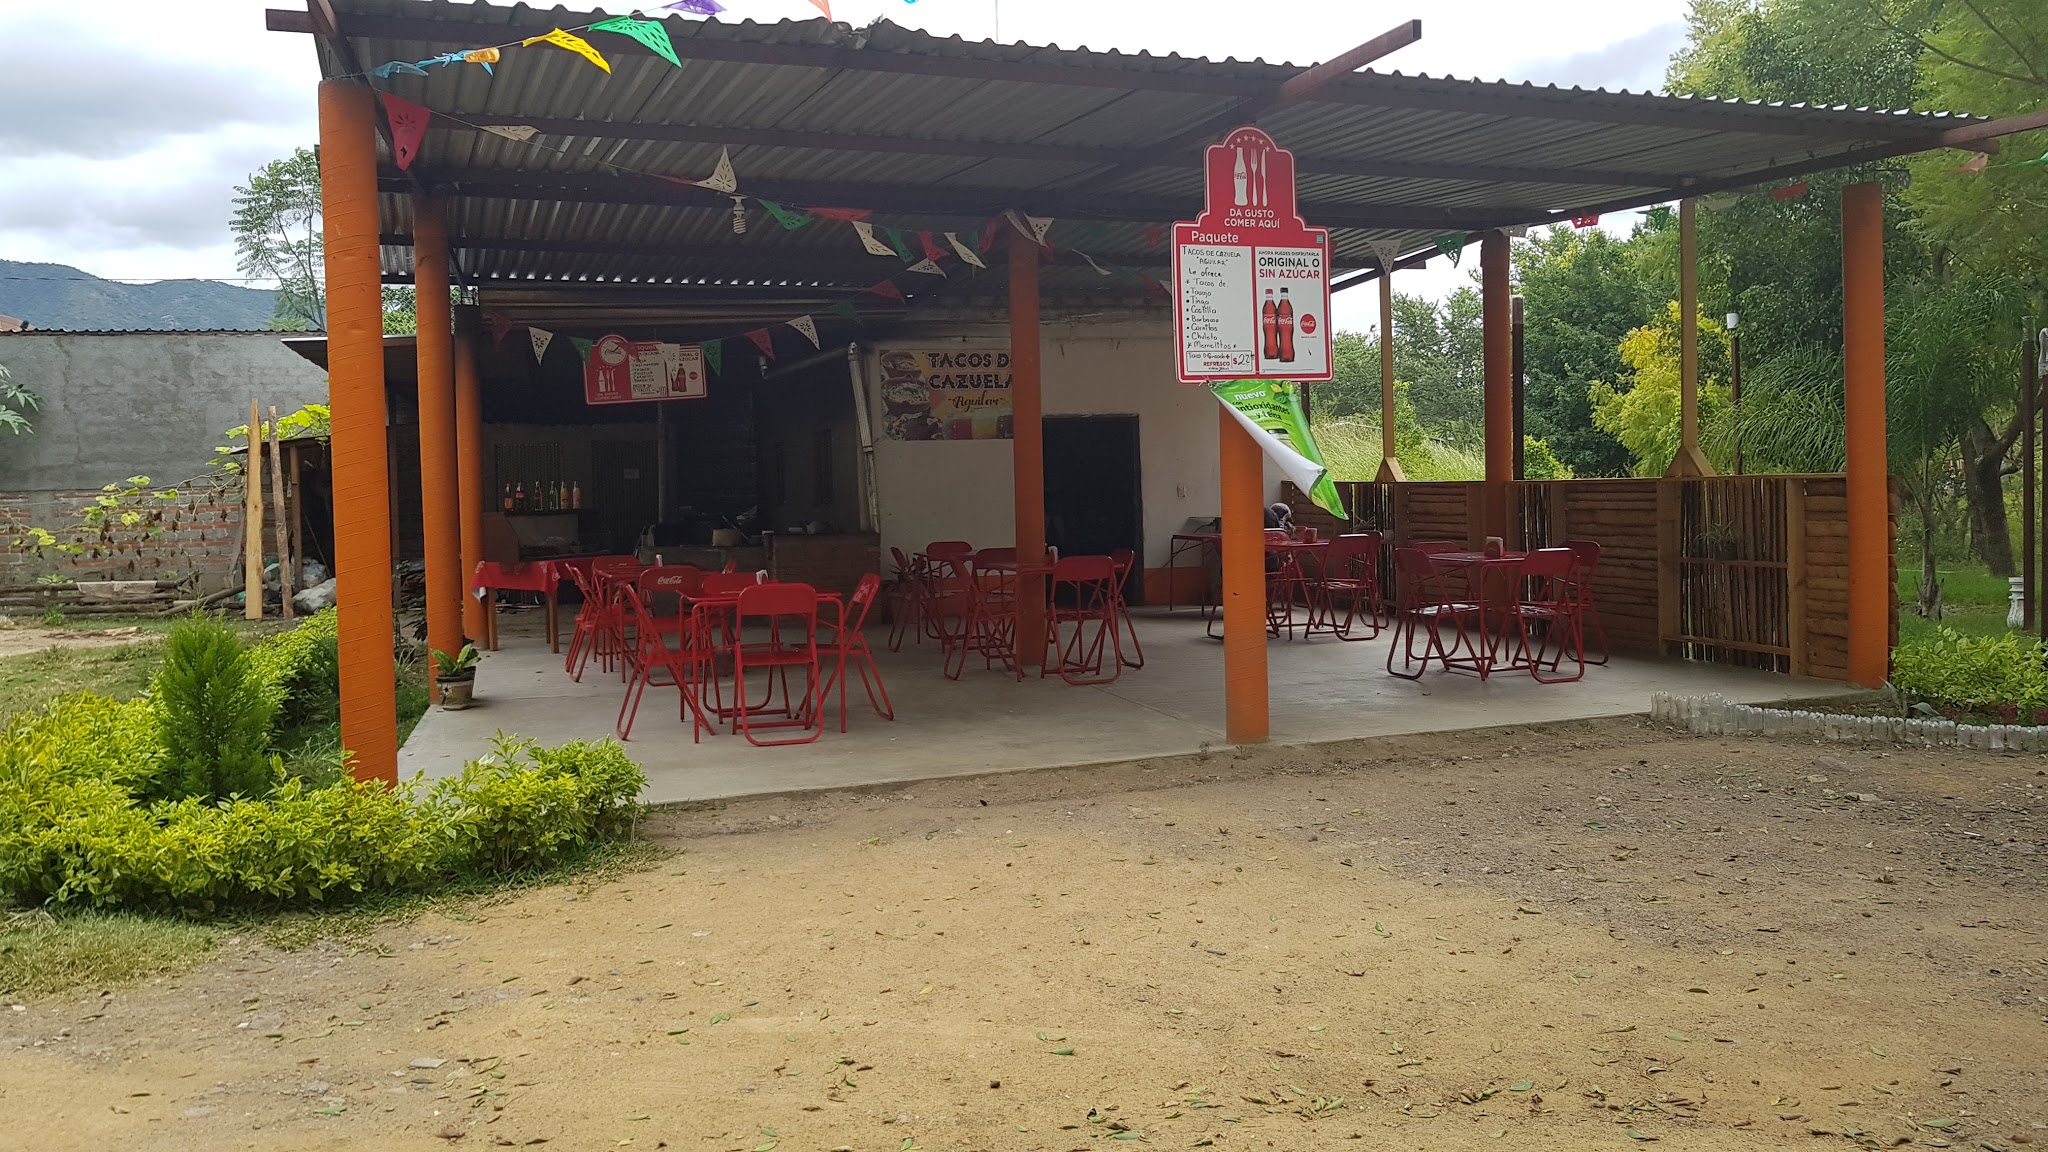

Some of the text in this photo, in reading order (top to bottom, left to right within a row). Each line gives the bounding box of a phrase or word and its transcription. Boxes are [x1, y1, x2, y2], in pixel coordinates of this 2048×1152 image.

[1229, 208, 1274, 218] DA GUSTO
[1224, 218, 1280, 228] COMER AQUÍ
[1191, 230, 1239, 244] Paquete
[1182, 246, 1204, 256] TACOS
[1216, 250, 1241, 258] CAZUELA
[1259, 257, 1320, 268] ORIGINAL O
[1200, 267, 1222, 277] ofrece
[1259, 269, 1276, 278] SIN
[1193, 278, 1215, 287] Tacos
[1190, 305, 1217, 314] Costilla
[928, 352, 1012, 368] TACOS D
[1234, 390, 1267, 401] nuevo
